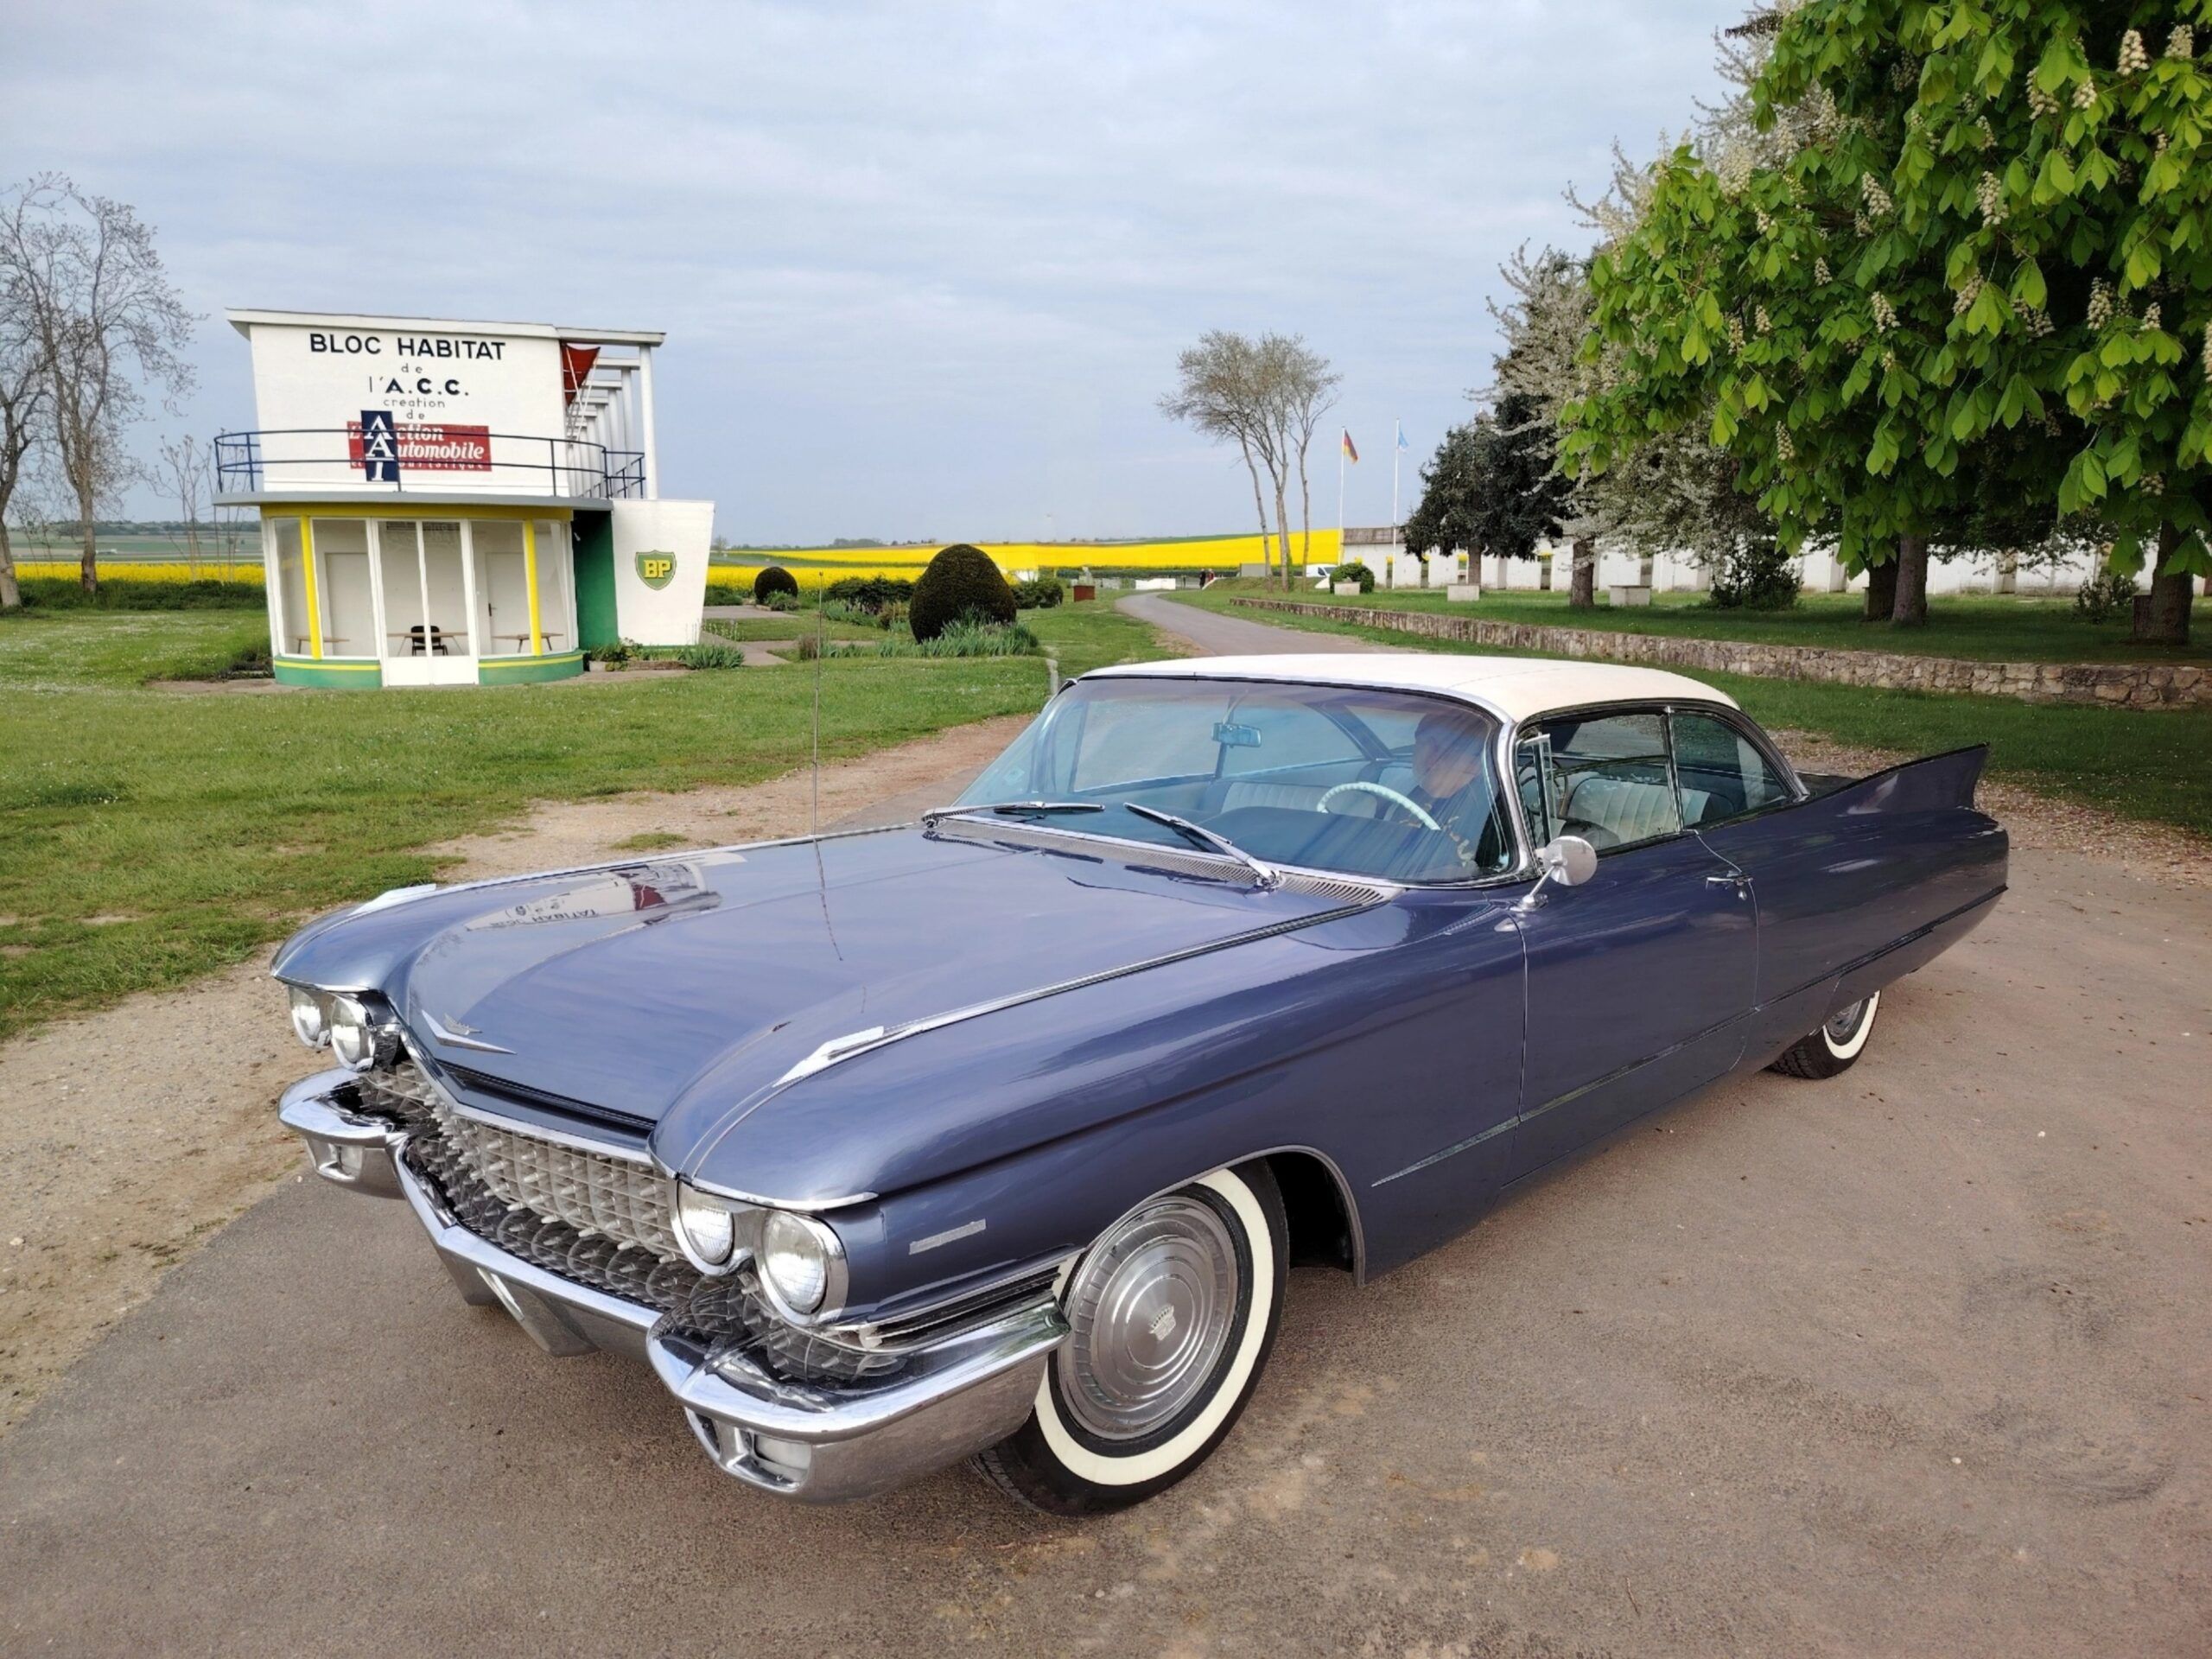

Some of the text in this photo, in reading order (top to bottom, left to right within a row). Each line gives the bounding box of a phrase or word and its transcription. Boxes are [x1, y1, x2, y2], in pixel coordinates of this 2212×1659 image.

[309, 333, 505, 360] BLOC HABITAT
[401, 363, 423, 374] de
[405, 410, 425, 420] de
[643, 559, 672, 579] BP
